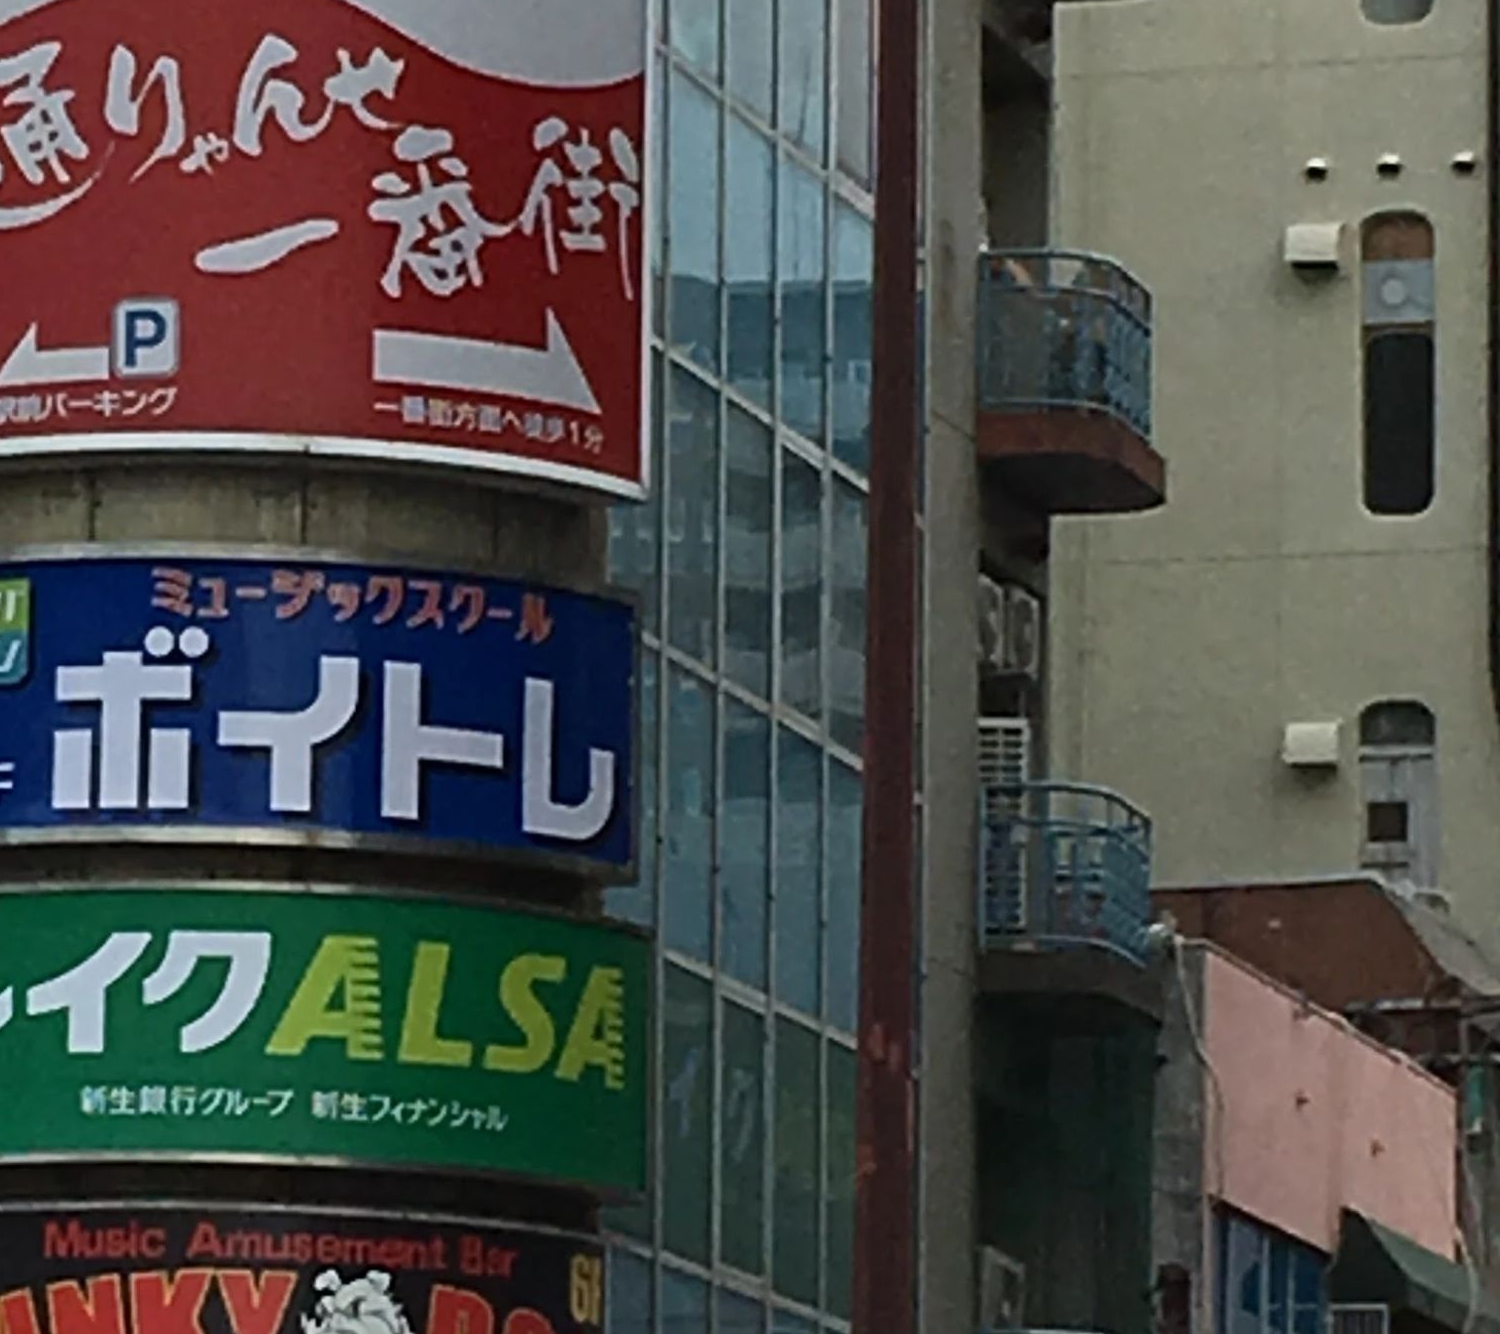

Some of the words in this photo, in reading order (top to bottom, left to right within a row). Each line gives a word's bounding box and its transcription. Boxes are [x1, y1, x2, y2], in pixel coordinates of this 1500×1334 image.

[124, 309, 167, 368] P
[151, 567, 555, 645] ミュージックスクール
[51, 624, 616, 841] ボイトレ
[79, 1083, 295, 1118] 新生銀行グループ
[309, 1089, 510, 1133] 新生フィナンシャル
[43, 1219, 166, 1260] Music
[186, 1220, 447, 1269] Amusement
[458, 1235, 519, 1278] Bar
